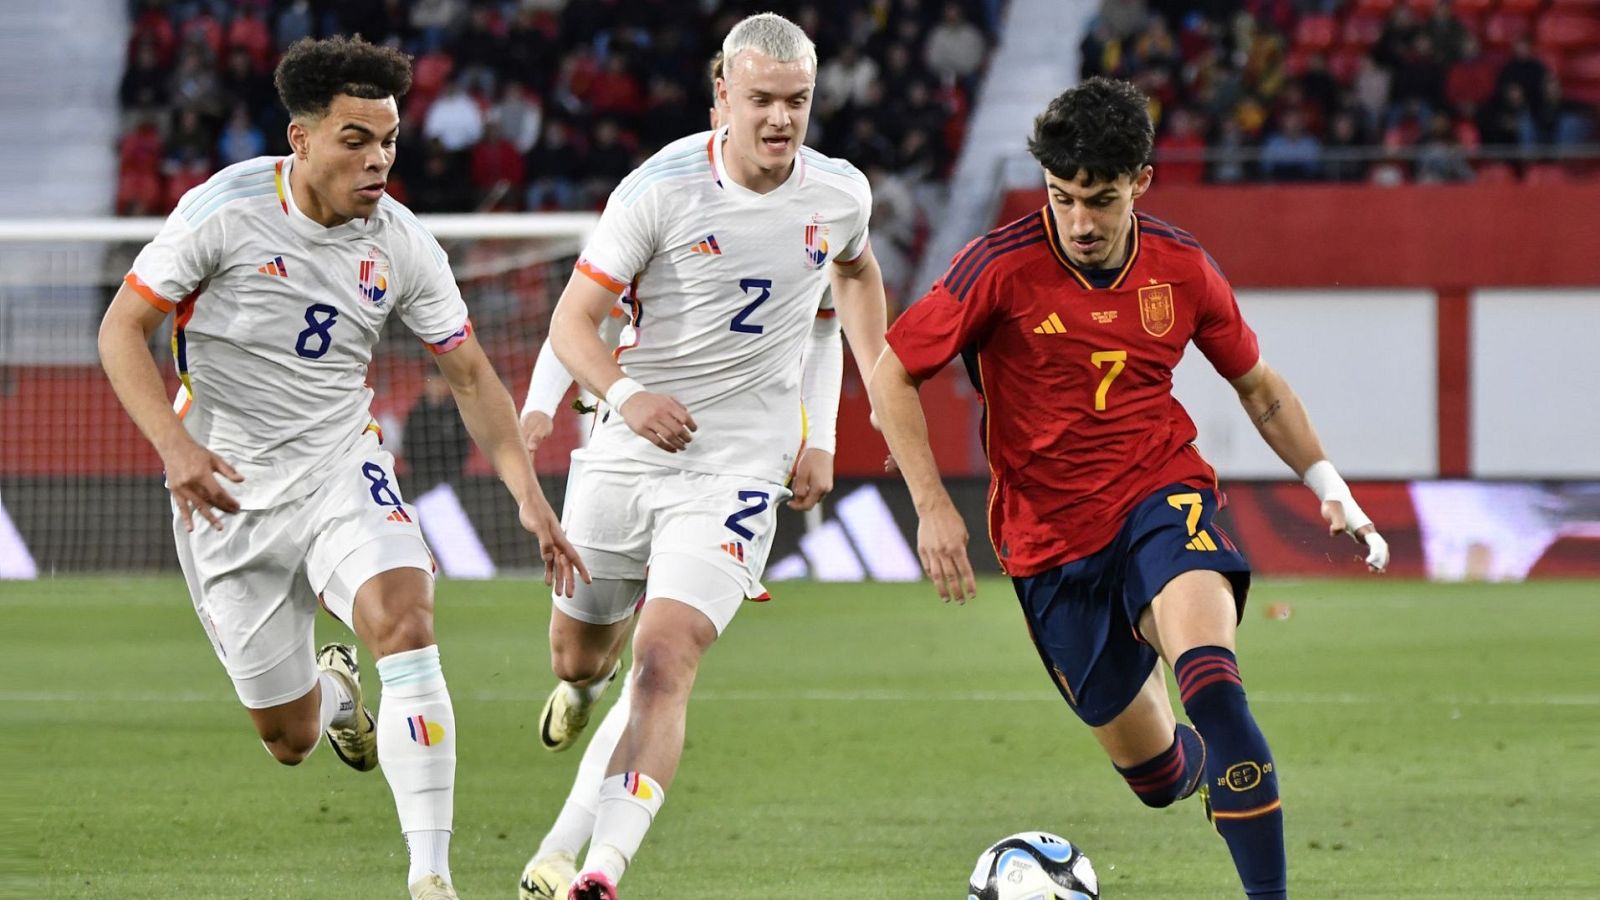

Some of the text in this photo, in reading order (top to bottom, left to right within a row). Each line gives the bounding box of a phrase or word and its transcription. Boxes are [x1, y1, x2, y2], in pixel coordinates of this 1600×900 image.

[295, 303, 339, 359] 8
[730, 279, 772, 334] 2
[1091, 351, 1127, 410] 7
[362, 462, 402, 508] 8
[724, 491, 769, 541] 2
[1167, 493, 1203, 536] 7
